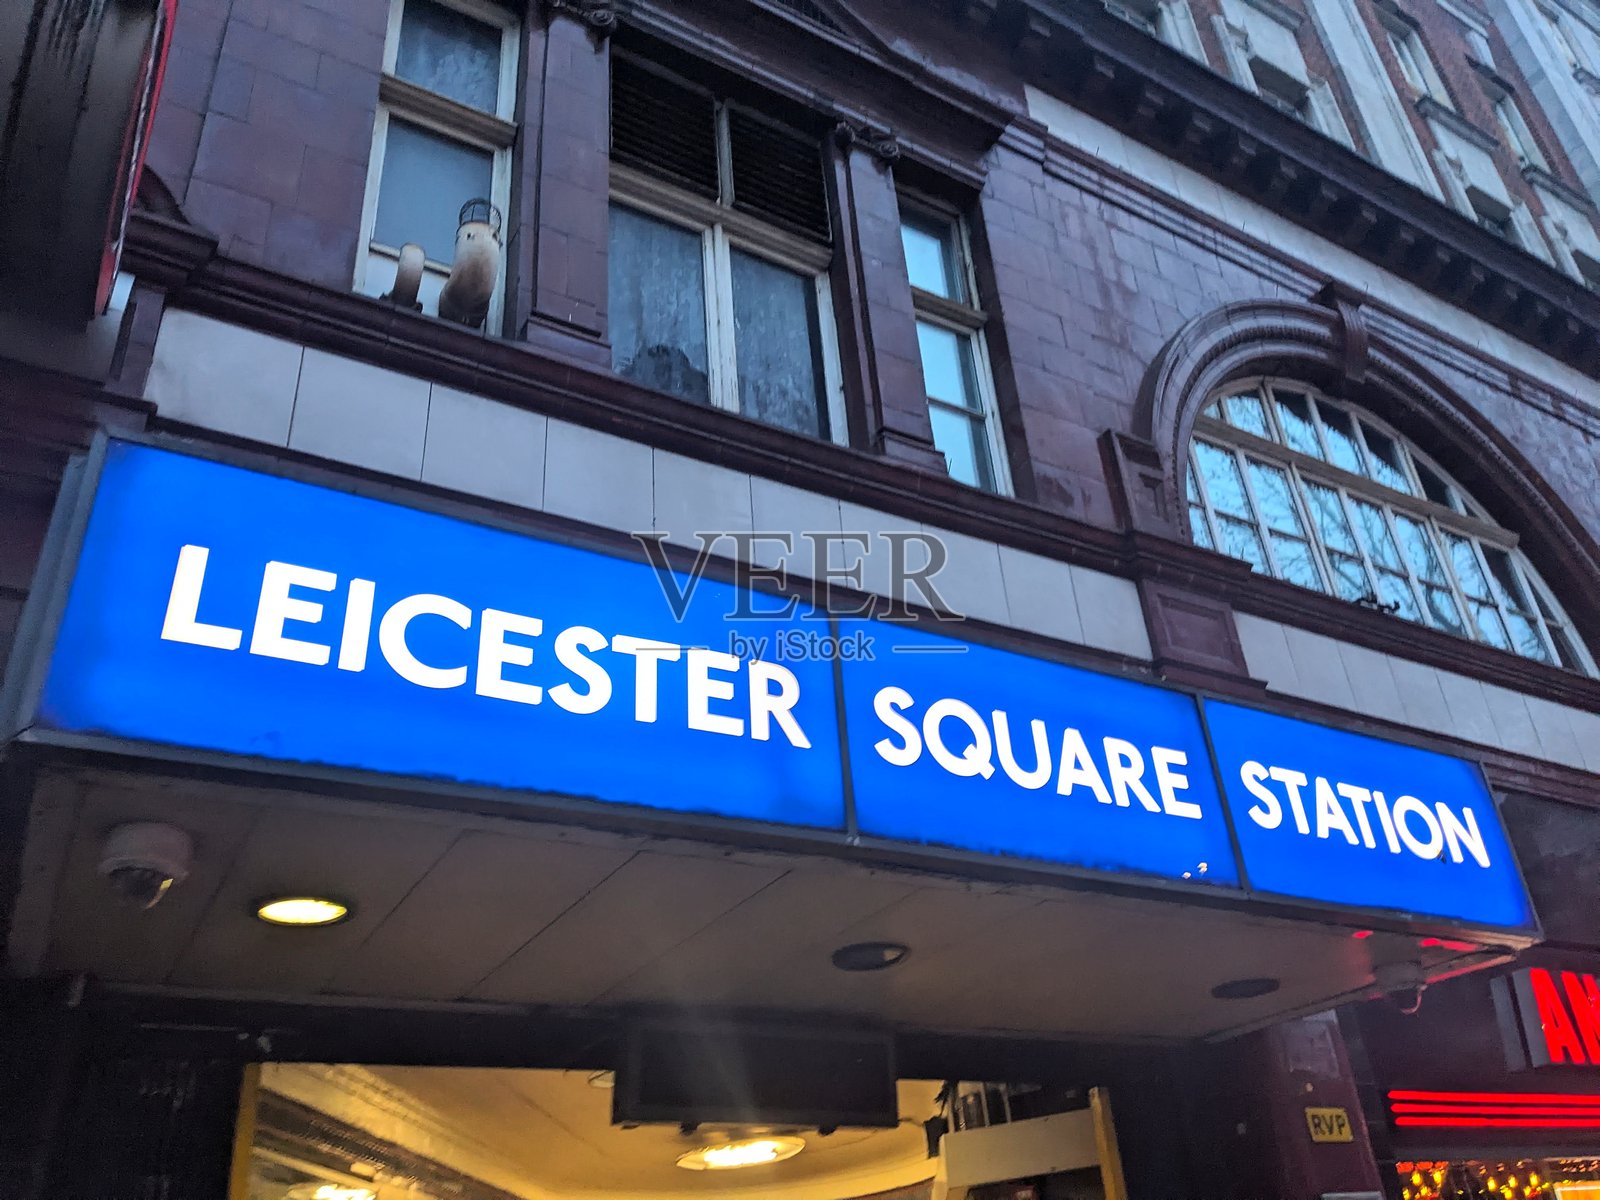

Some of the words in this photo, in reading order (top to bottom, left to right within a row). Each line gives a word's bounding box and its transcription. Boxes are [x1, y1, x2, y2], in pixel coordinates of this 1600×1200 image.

[161, 544, 811, 749] LEICESTER
[873, 686, 1203, 819] SQUARE
[1240, 760, 1491, 868] STATION
[1311, 1114, 1346, 1135] RVP
